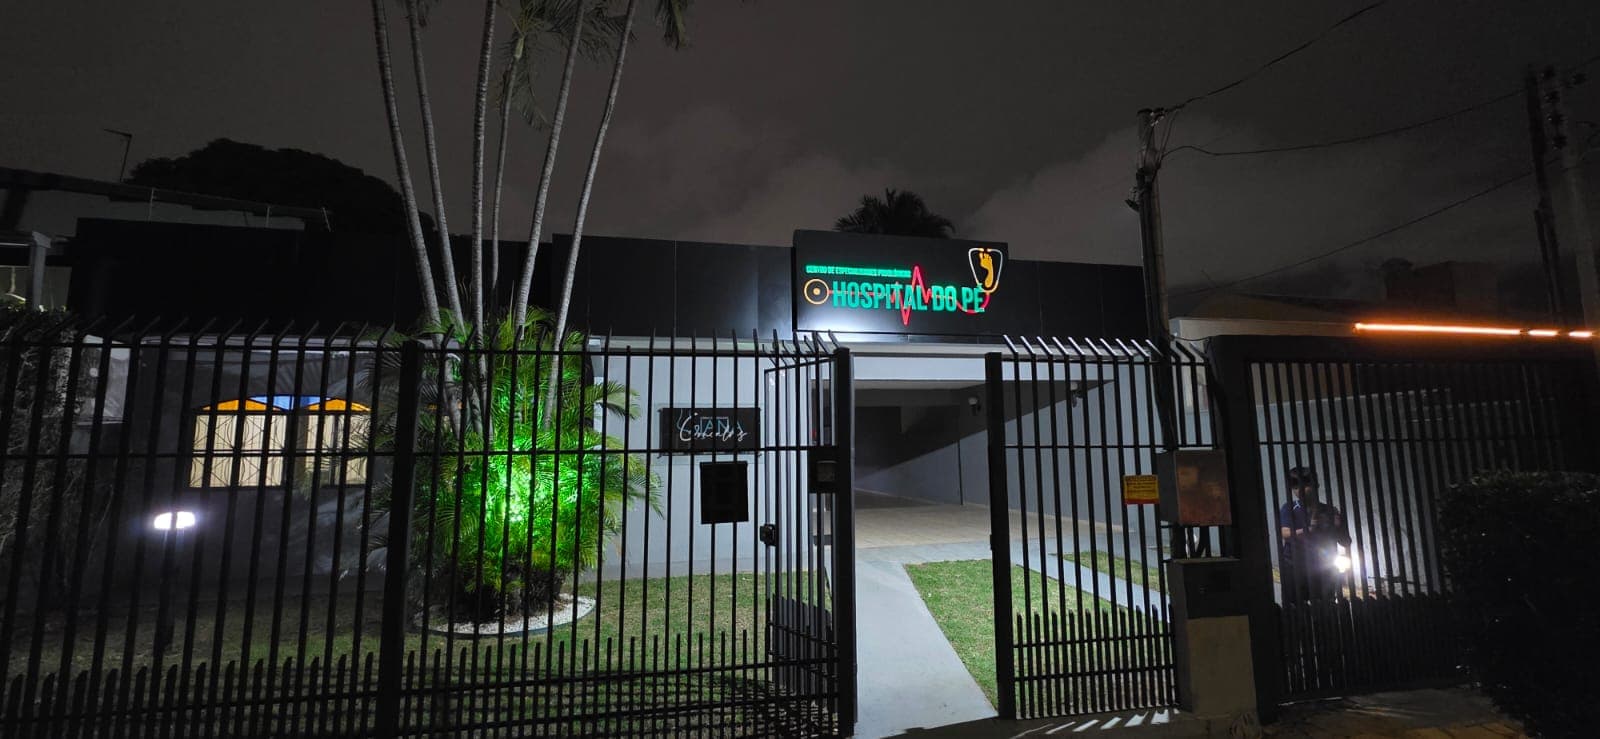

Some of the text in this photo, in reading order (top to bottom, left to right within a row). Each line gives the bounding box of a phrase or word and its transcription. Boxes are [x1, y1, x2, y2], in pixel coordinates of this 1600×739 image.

[832, 281, 985, 313] HOSPITAL DO PÉ
